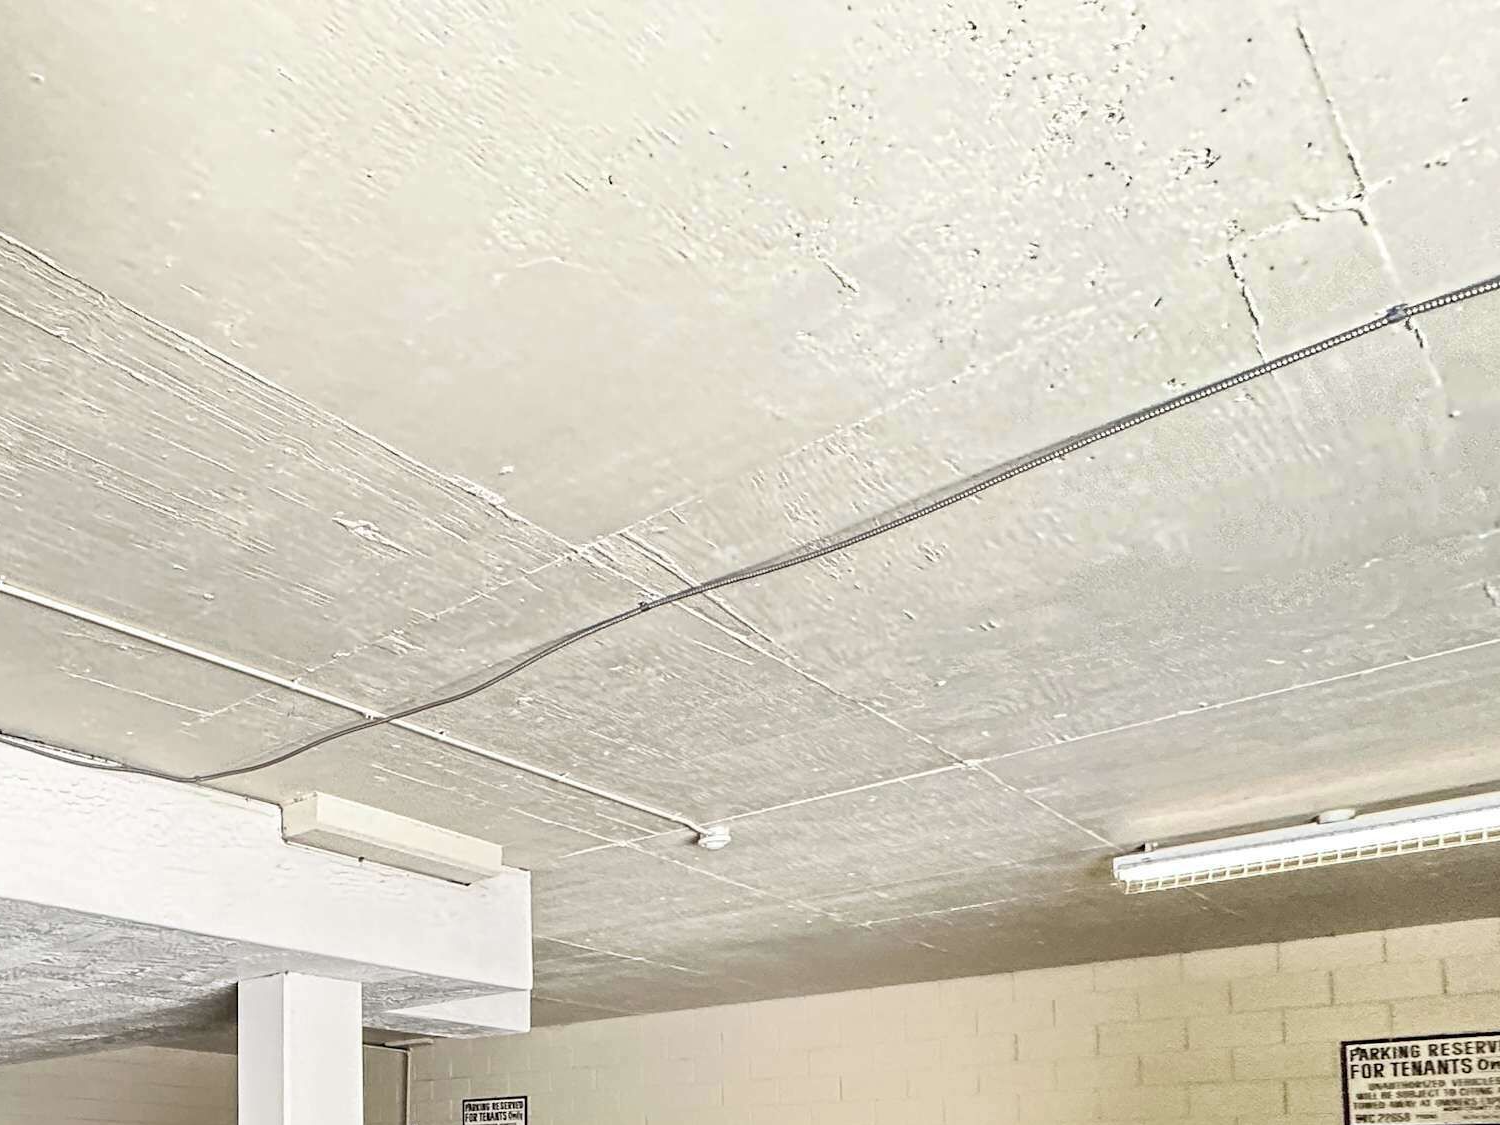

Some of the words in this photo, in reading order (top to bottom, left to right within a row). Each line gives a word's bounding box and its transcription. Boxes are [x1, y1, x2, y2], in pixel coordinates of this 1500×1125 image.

[1350, 1045, 1421, 1061] PARKING
[1428, 1040, 1500, 1057] RESERV
[1350, 1063, 1385, 1079] FOR
[1389, 1058, 1473, 1077] TENANTS
[465, 1103, 490, 1112] PARKING
[492, 1101, 523, 1110] RESERVED
[465, 1113, 478, 1122] FOR
[479, 1111, 507, 1121] TENANTS
